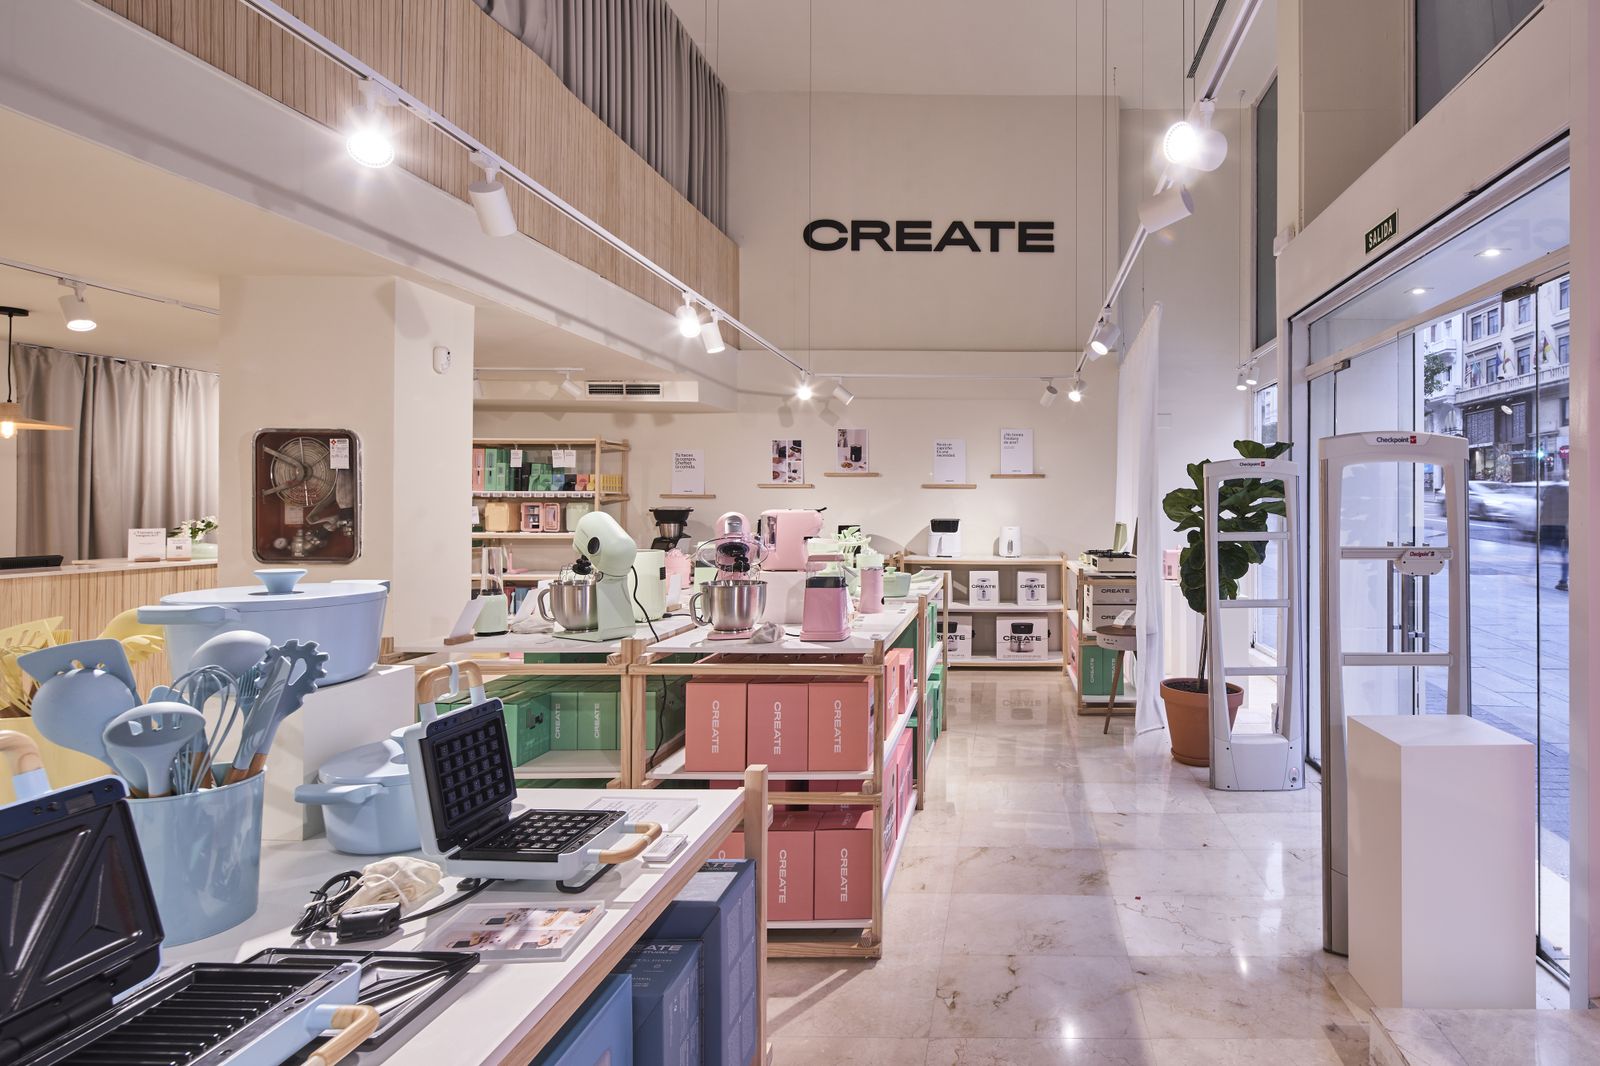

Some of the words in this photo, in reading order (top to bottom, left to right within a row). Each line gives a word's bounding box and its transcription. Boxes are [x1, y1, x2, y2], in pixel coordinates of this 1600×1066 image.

[803, 219, 1055, 253] CREATE
[1368, 219, 1393, 249] SALIDA
[1376, 436, 1409, 444] Checkpoint
[712, 700, 720, 754] CREATE
[774, 701, 782, 755] CREATE
[834, 700, 842, 753] CREATE
[779, 850, 787, 903] CREATE
